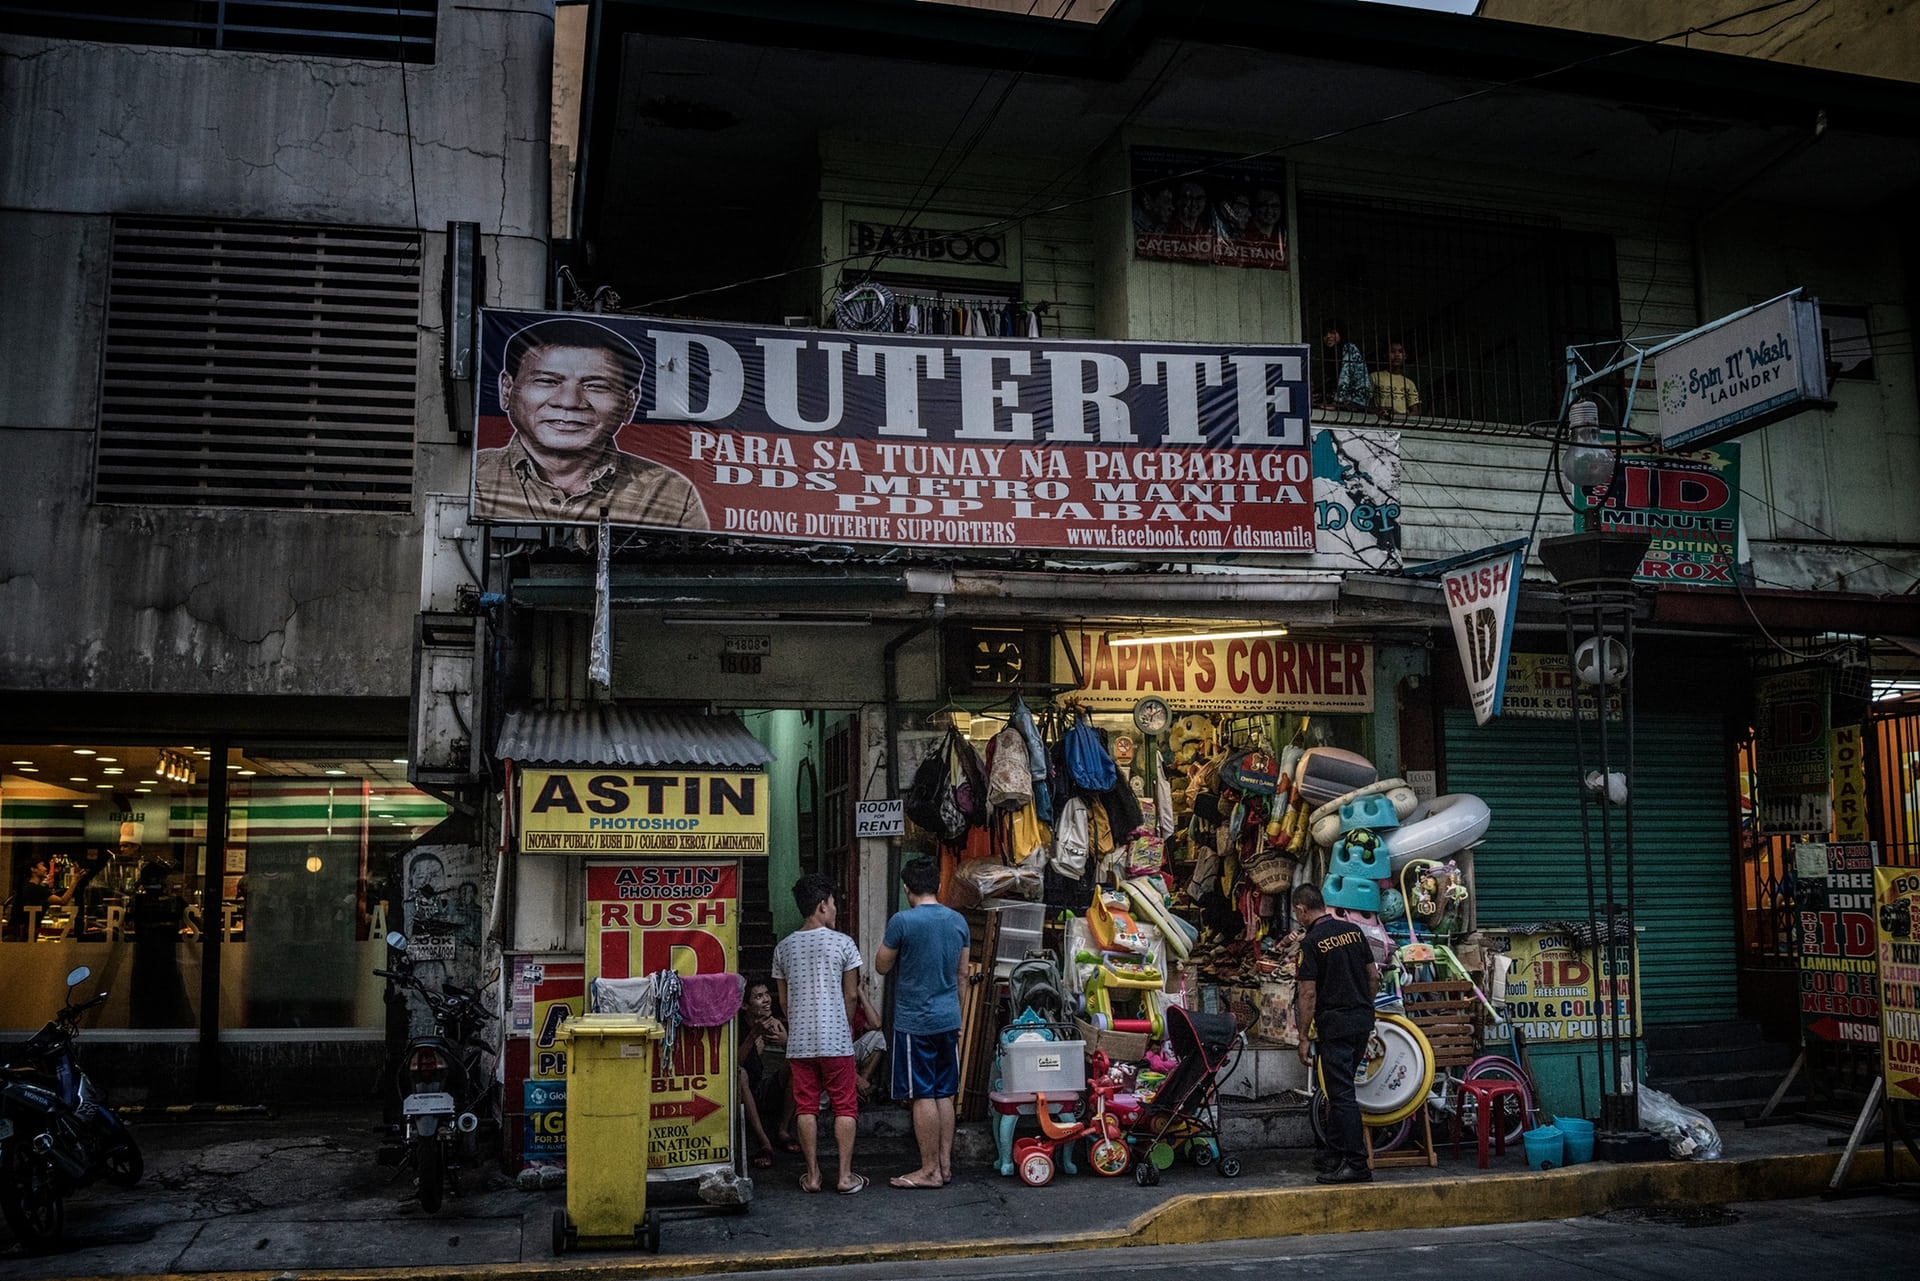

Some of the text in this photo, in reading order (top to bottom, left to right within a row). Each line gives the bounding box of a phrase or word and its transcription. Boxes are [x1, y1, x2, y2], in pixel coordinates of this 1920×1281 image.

[859, 223, 1000, 262] BAMBOO
[1136, 239, 1210, 253] CAYETANO
[1689, 368, 1723, 399] Spin
[1745, 333, 1791, 369] Wash
[646, 329, 1305, 446] DUTERTE
[1711, 365, 1780, 404] LAUNDRY
[689, 432, 1309, 483] PARA SA TUNAY NA PAGBABAGO
[1663, 460, 1719, 472] studio
[713, 465, 1306, 504] DDS METRO MANILA
[1625, 466, 1730, 512] ID
[835, 494, 1234, 522] PDP LABAN
[724, 507, 1313, 548] DIGONG DUTERTE SUPPORTERS www.facebook.com/ddsmanila
[1602, 509, 1734, 531] MINUTE
[1650, 540, 1734, 554] EDITING
[1446, 562, 1509, 608] RUSH
[735, 639, 761, 650] 1808
[1463, 607, 1497, 683] ID
[720, 655, 761, 673] 1808
[1074, 635, 1367, 695] JAPAN'S CORNER
[1504, 696, 1538, 708] EROX
[1775, 701, 1824, 746] ID
[1409, 773, 1432, 781] LOAD
[1836, 729, 1857, 830] NOTARY
[531, 774, 755, 815] ASTIN
[859, 801, 902, 813] ROOM
[589, 818, 700, 830] PHOTOSHOP
[859, 820, 902, 831] RENT
[528, 833, 562, 848] NOTARY
[563, 834, 594, 848] PUBLIC
[600, 835, 622, 848] RUSH
[624, 835, 634, 848] ID
[640, 835, 677, 849] COLORED
[680, 836, 706, 849] XEROX
[712, 836, 762, 850] LAMINATION
[616, 867, 720, 884] ASTIN
[1827, 873, 1873, 888] FREE
[620, 885, 713, 898] PHOTOSHOP
[1828, 894, 1874, 909] EDIT
[601, 901, 727, 928] RUSH
[1317, 931, 1362, 953] SECURITY
[1800, 911, 1820, 955] RUSH
[1819, 911, 1876, 957] ID
[600, 929, 727, 979] ID
[1542, 960, 1590, 986] ID
[1534, 987, 1588, 998] FREE EDITING
[1544, 1003, 1556, 1017] &
[24, 1090, 48, 1106] HONDA
[534, 1135, 552, 1143] FOR
[654, 1125, 688, 1139] XEROX
[668, 1149, 708, 1164] RUSH
[713, 1147, 729, 1159] ID
